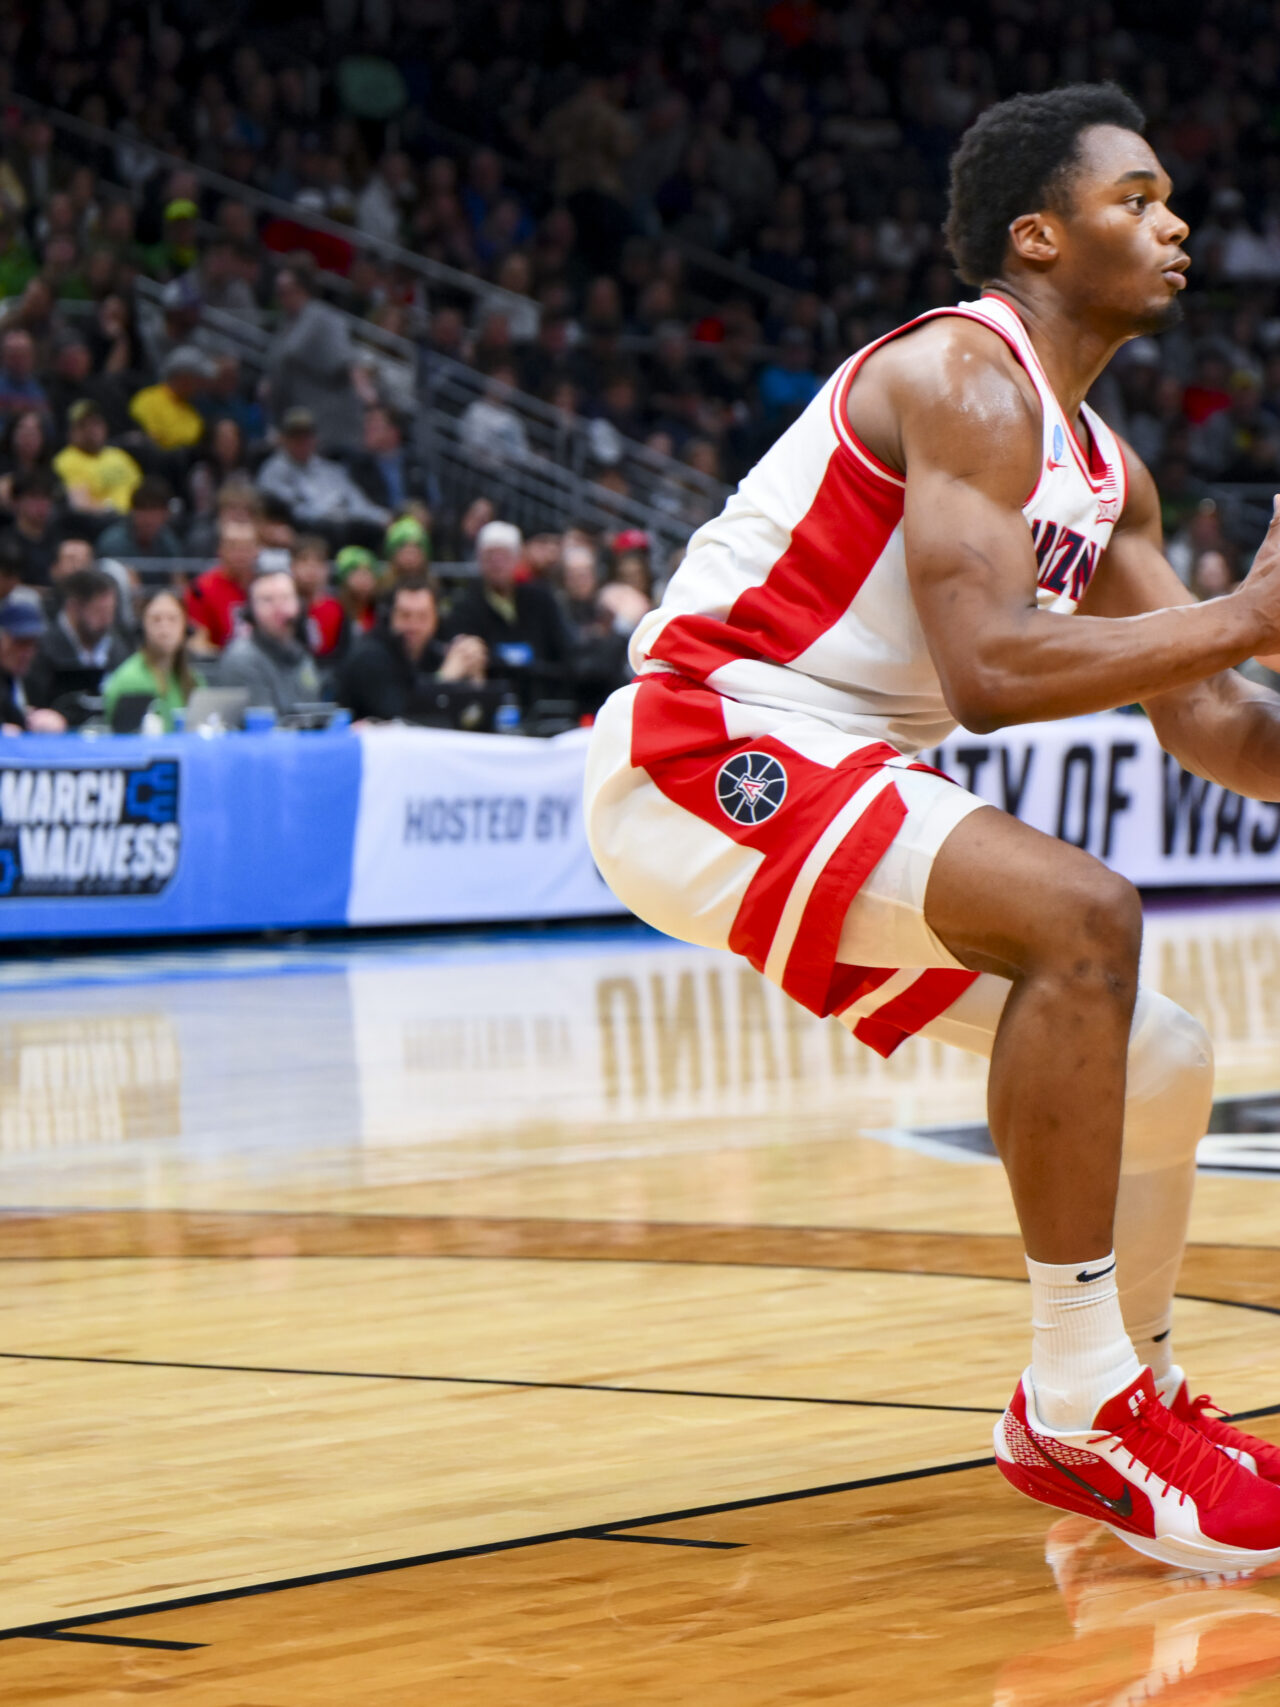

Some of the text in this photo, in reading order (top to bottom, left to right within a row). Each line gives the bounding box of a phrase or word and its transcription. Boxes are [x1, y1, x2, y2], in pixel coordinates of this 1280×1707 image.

[0, 769, 126, 824] MARCH
[403, 796, 576, 845] HOSTED BY
[1056, 742, 1138, 859] OF
[19, 822, 181, 881] MADNESS
